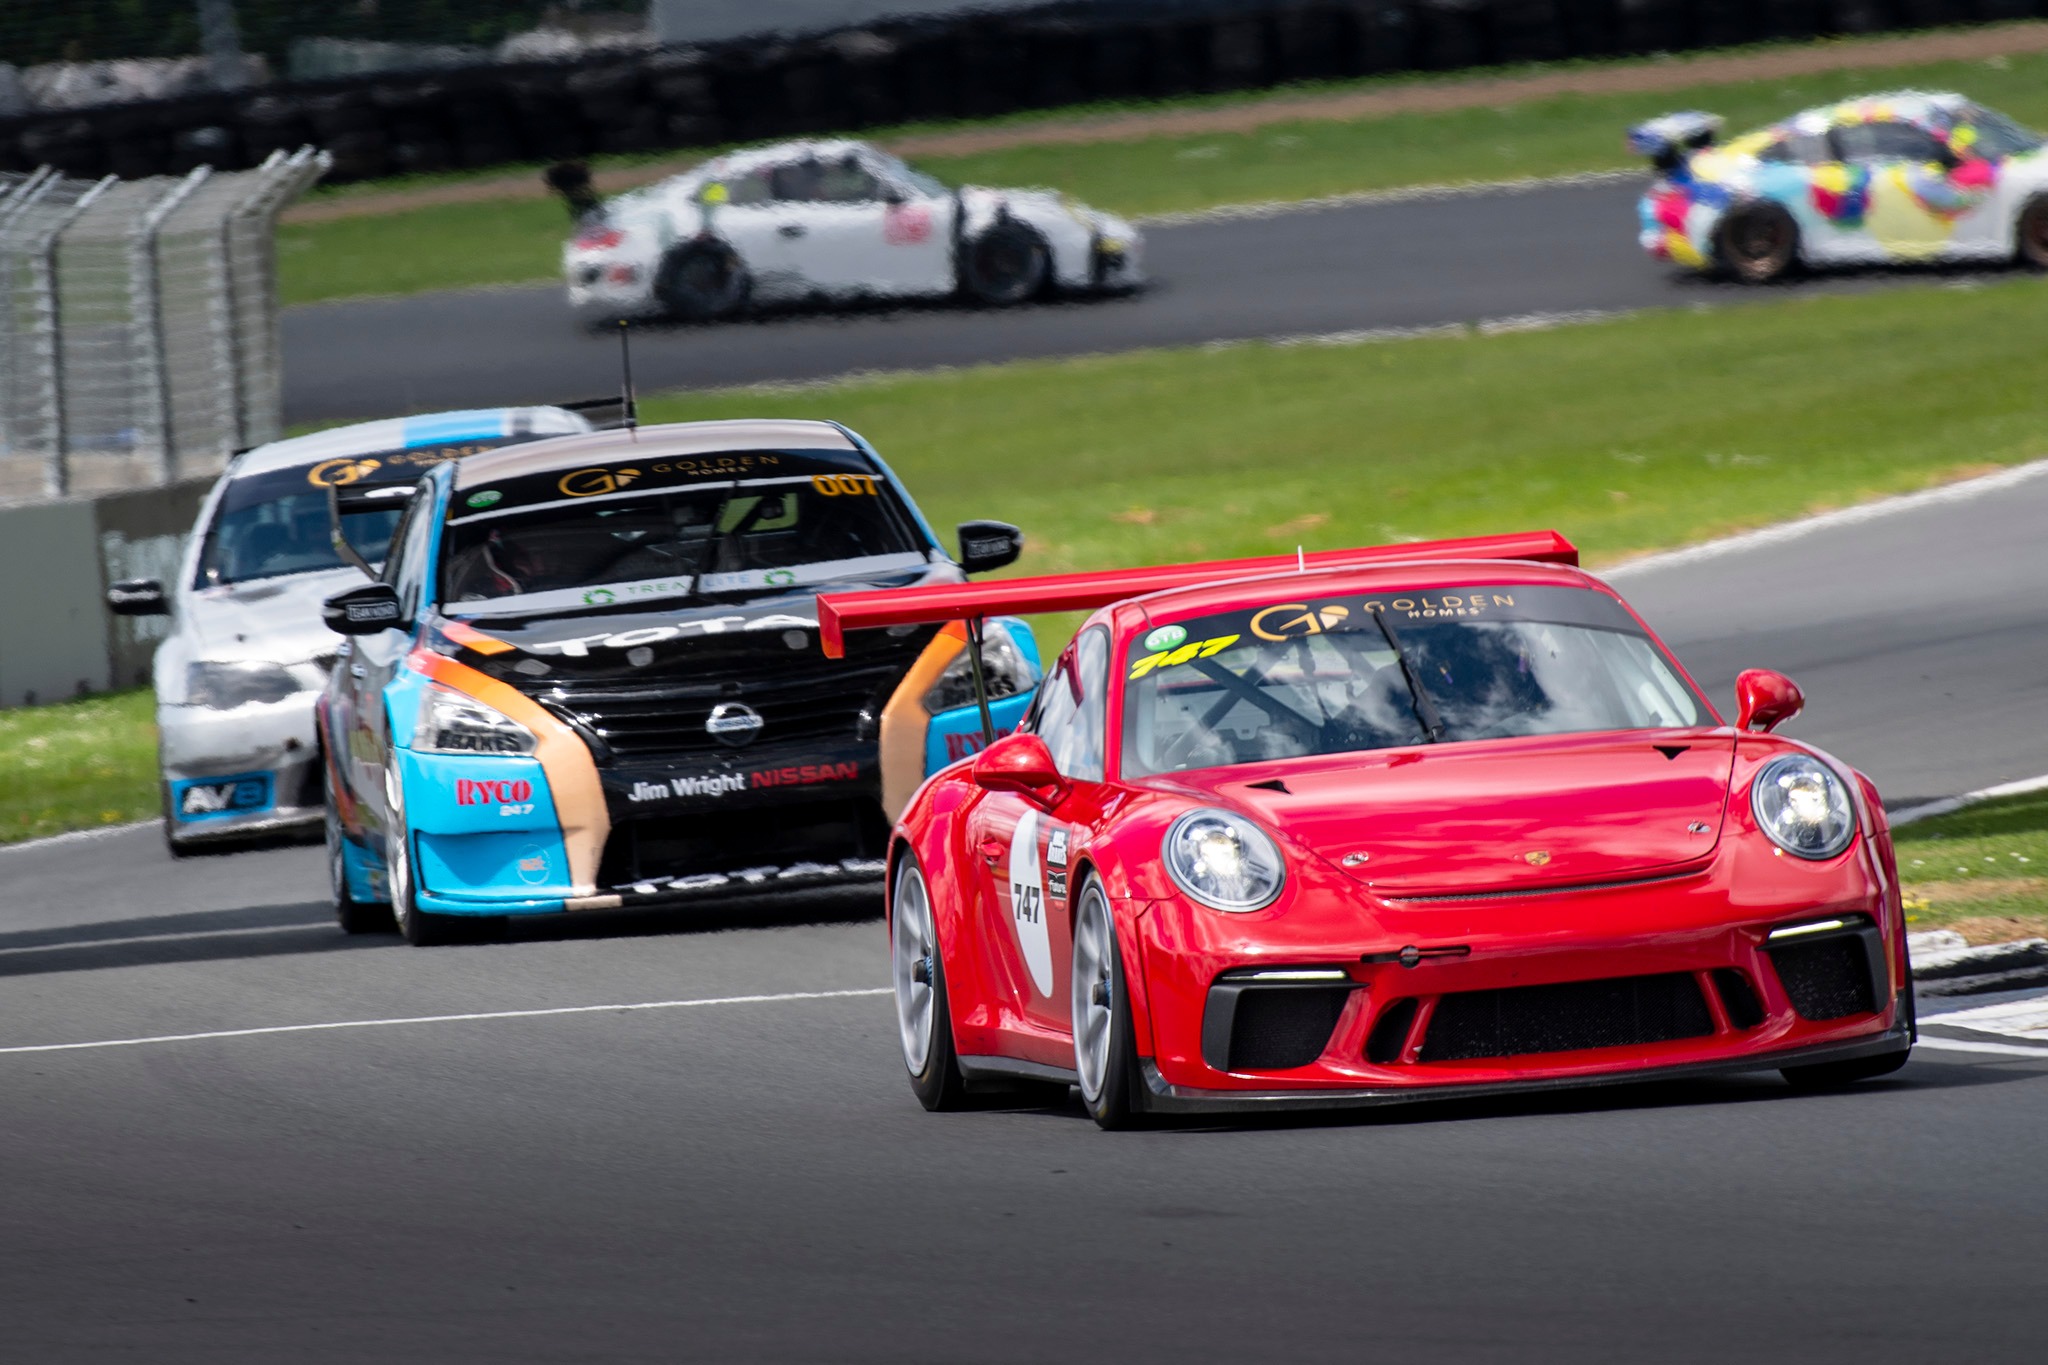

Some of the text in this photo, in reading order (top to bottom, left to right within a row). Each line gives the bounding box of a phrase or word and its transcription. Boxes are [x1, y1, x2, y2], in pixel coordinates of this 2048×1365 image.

[651, 455, 779, 473] GOLDEN
[687, 466, 748, 476] HOMES
[812, 474, 877, 496] 007
[627, 573, 751, 594] TREALITE
[1363, 594, 1515, 614] GOLDEN
[1407, 607, 1480, 619] HOMES
[533, 614, 821, 657] TOTA
[456, 779, 532, 806] RYCO
[628, 761, 858, 802] Jim Wright NISSAN
[182, 781, 263, 815] AV8
[1014, 882, 1041, 925] 747
